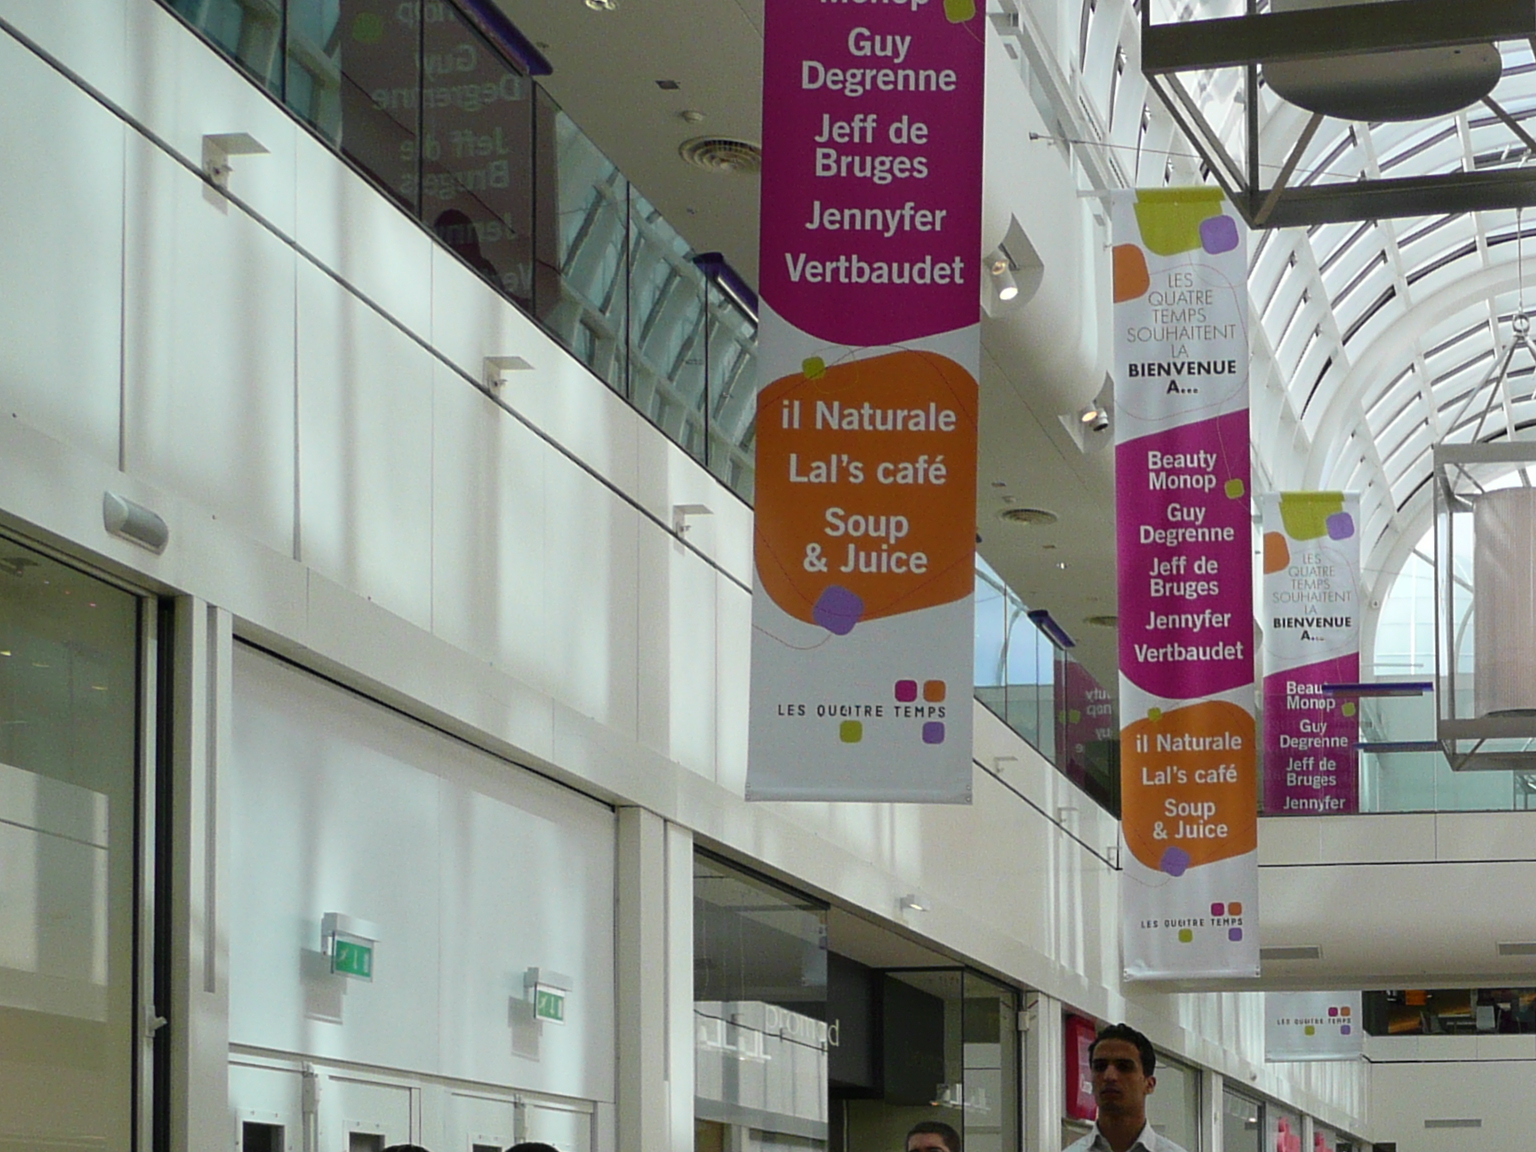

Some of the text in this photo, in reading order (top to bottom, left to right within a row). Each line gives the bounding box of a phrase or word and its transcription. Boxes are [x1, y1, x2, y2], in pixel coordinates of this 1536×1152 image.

[848, 27, 912, 63] Guy
[801, 60, 957, 97] Degrenne
[814, 113, 929, 145] Jeff de
[815, 147, 929, 185] Bruges
[805, 200, 947, 238] Jennyfer
[785, 253, 964, 285] Vertbaudet
[1168, 273, 1193, 288] LES
[1148, 290, 1213, 306] QUATRE
[1152, 308, 1207, 324] TEMPS
[1126, 324, 1236, 342] SOUHAITENT
[1171, 344, 1189, 358] LA
[1128, 360, 1236, 377] BIENVENUE
[781, 400, 956, 432] il Naturale
[876, 455, 947, 485] café
[1148, 450, 1217, 471] Beauty
[1149, 471, 1217, 493] Monop
[1167, 503, 1206, 525] Guy
[824, 507, 909, 544] Soup
[1139, 525, 1235, 546] Degrenne
[803, 543, 928, 574] & Juice
[1149, 556, 1218, 576] Jeff de
[1303, 553, 1321, 565] LES
[1288, 566, 1335, 578] QUATRE
[1150, 579, 1219, 599] Bruges
[1292, 579, 1330, 590] TEMPS
[1272, 591, 1351, 603] SOUHAITENT
[1304, 604, 1317, 615] LA
[1145, 609, 1231, 632] Jennyfer
[1273, 617, 1351, 628] BIENVENUE
[1134, 641, 1244, 663] Vertbaudet
[778, 704, 806, 716] LES
[894, 706, 946, 718] TEMPS
[1286, 695, 1336, 712] Monop
[1300, 719, 1327, 735] Guy
[1136, 732, 1242, 752] il Naturale
[1280, 735, 1348, 750] Degrenne
[1195, 764, 1238, 783] café
[1286, 757, 1336, 771] Jeff de
[1287, 773, 1337, 789] Bruges
[1164, 799, 1216, 820] Soup
[1283, 795, 1346, 811] Jennyfer
[1153, 820, 1228, 839] & Juice
[1141, 920, 1158, 928] LES
[1210, 918, 1243, 927] TEMPS
